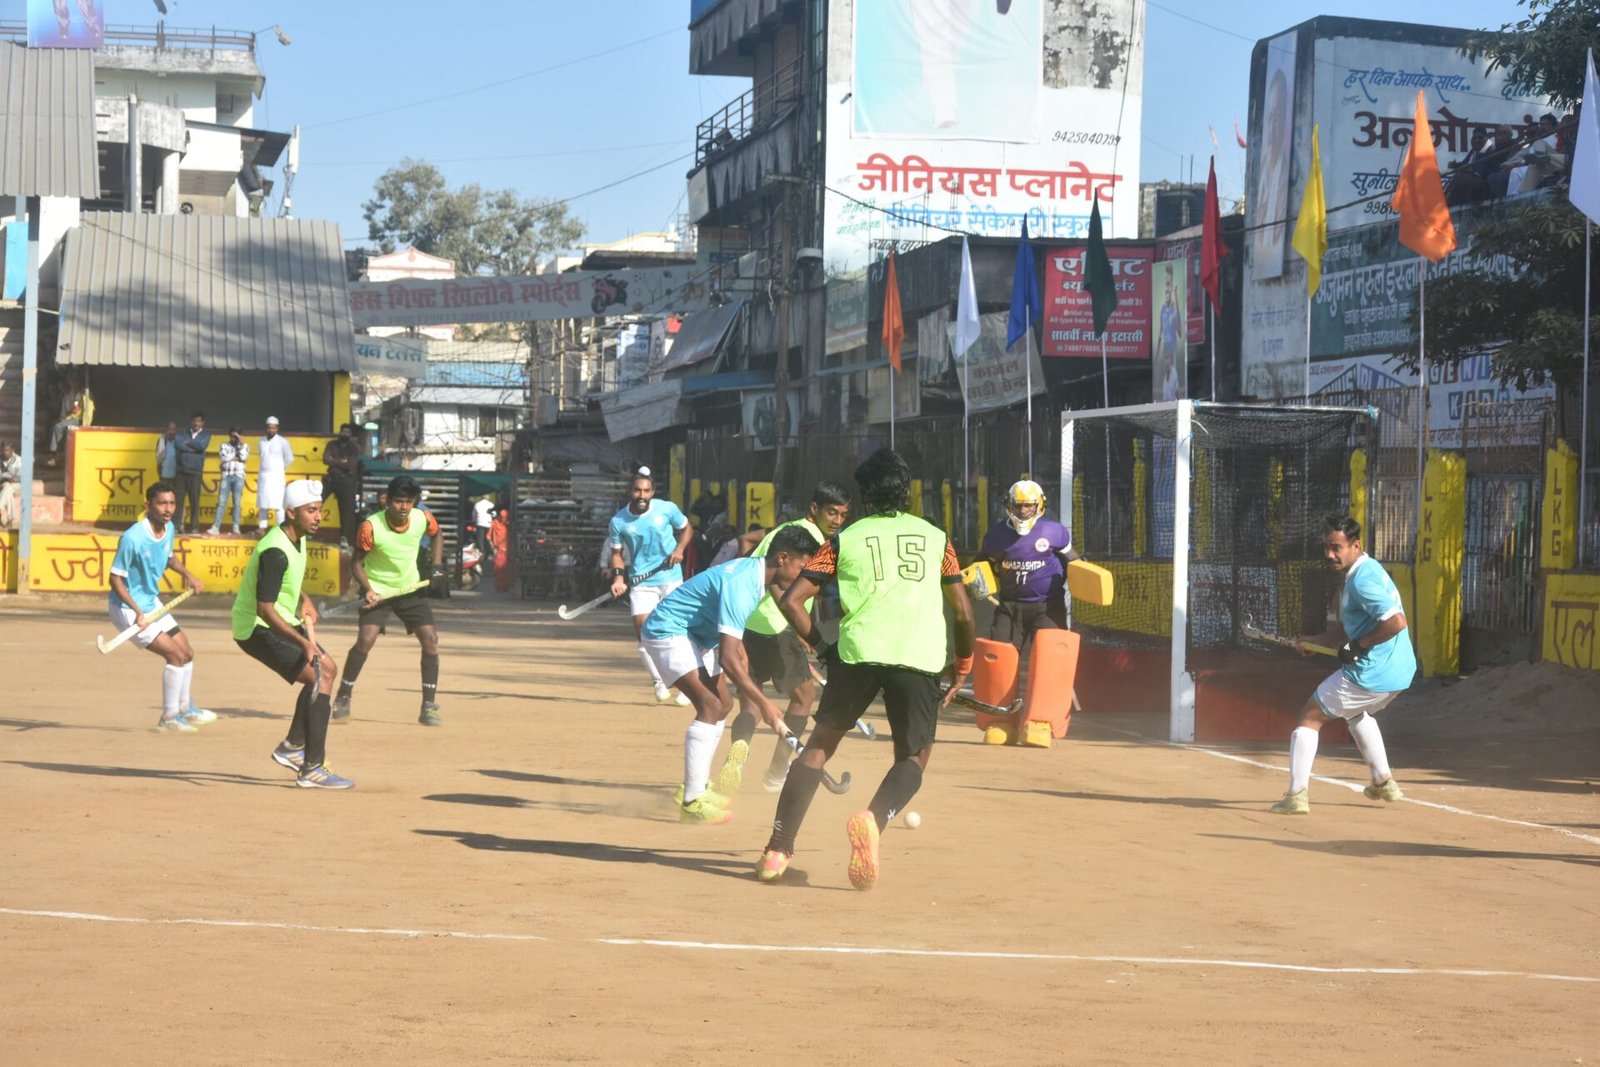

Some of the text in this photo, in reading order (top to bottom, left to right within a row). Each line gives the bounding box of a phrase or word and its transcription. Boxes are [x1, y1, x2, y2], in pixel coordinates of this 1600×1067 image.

[1369, 67, 1397, 86] दिन
[1394, 66, 1434, 89] आपके
[857, 153, 1123, 202] जीनियस प्लानेट
[96, 467, 146, 497] एल
[200, 545, 240, 558] सराफा
[866, 534, 926, 582] 15
